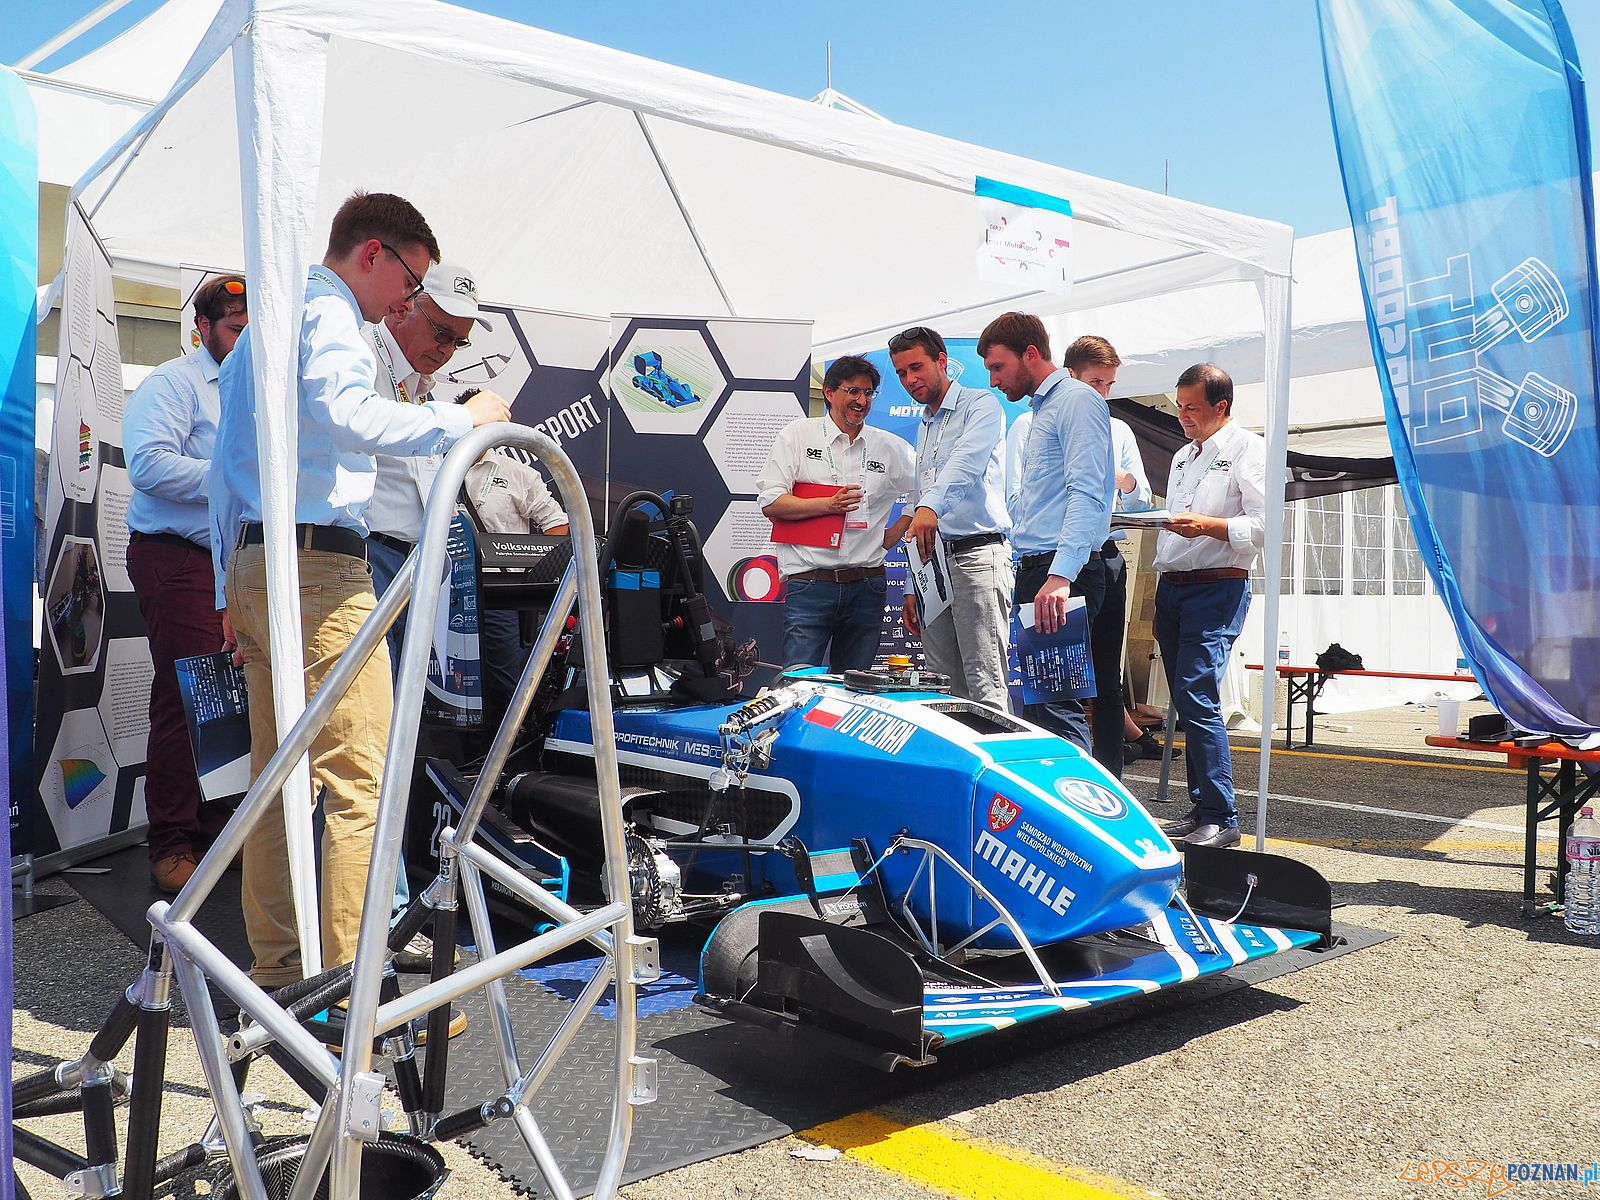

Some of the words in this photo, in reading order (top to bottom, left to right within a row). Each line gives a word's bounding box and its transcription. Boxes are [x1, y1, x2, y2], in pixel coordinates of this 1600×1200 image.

[613, 731, 679, 750] PROFITECHNIK
[1016, 830, 1067, 868] WIELKOPOLSKIEGO
[974, 829, 1076, 917] MAHLE
